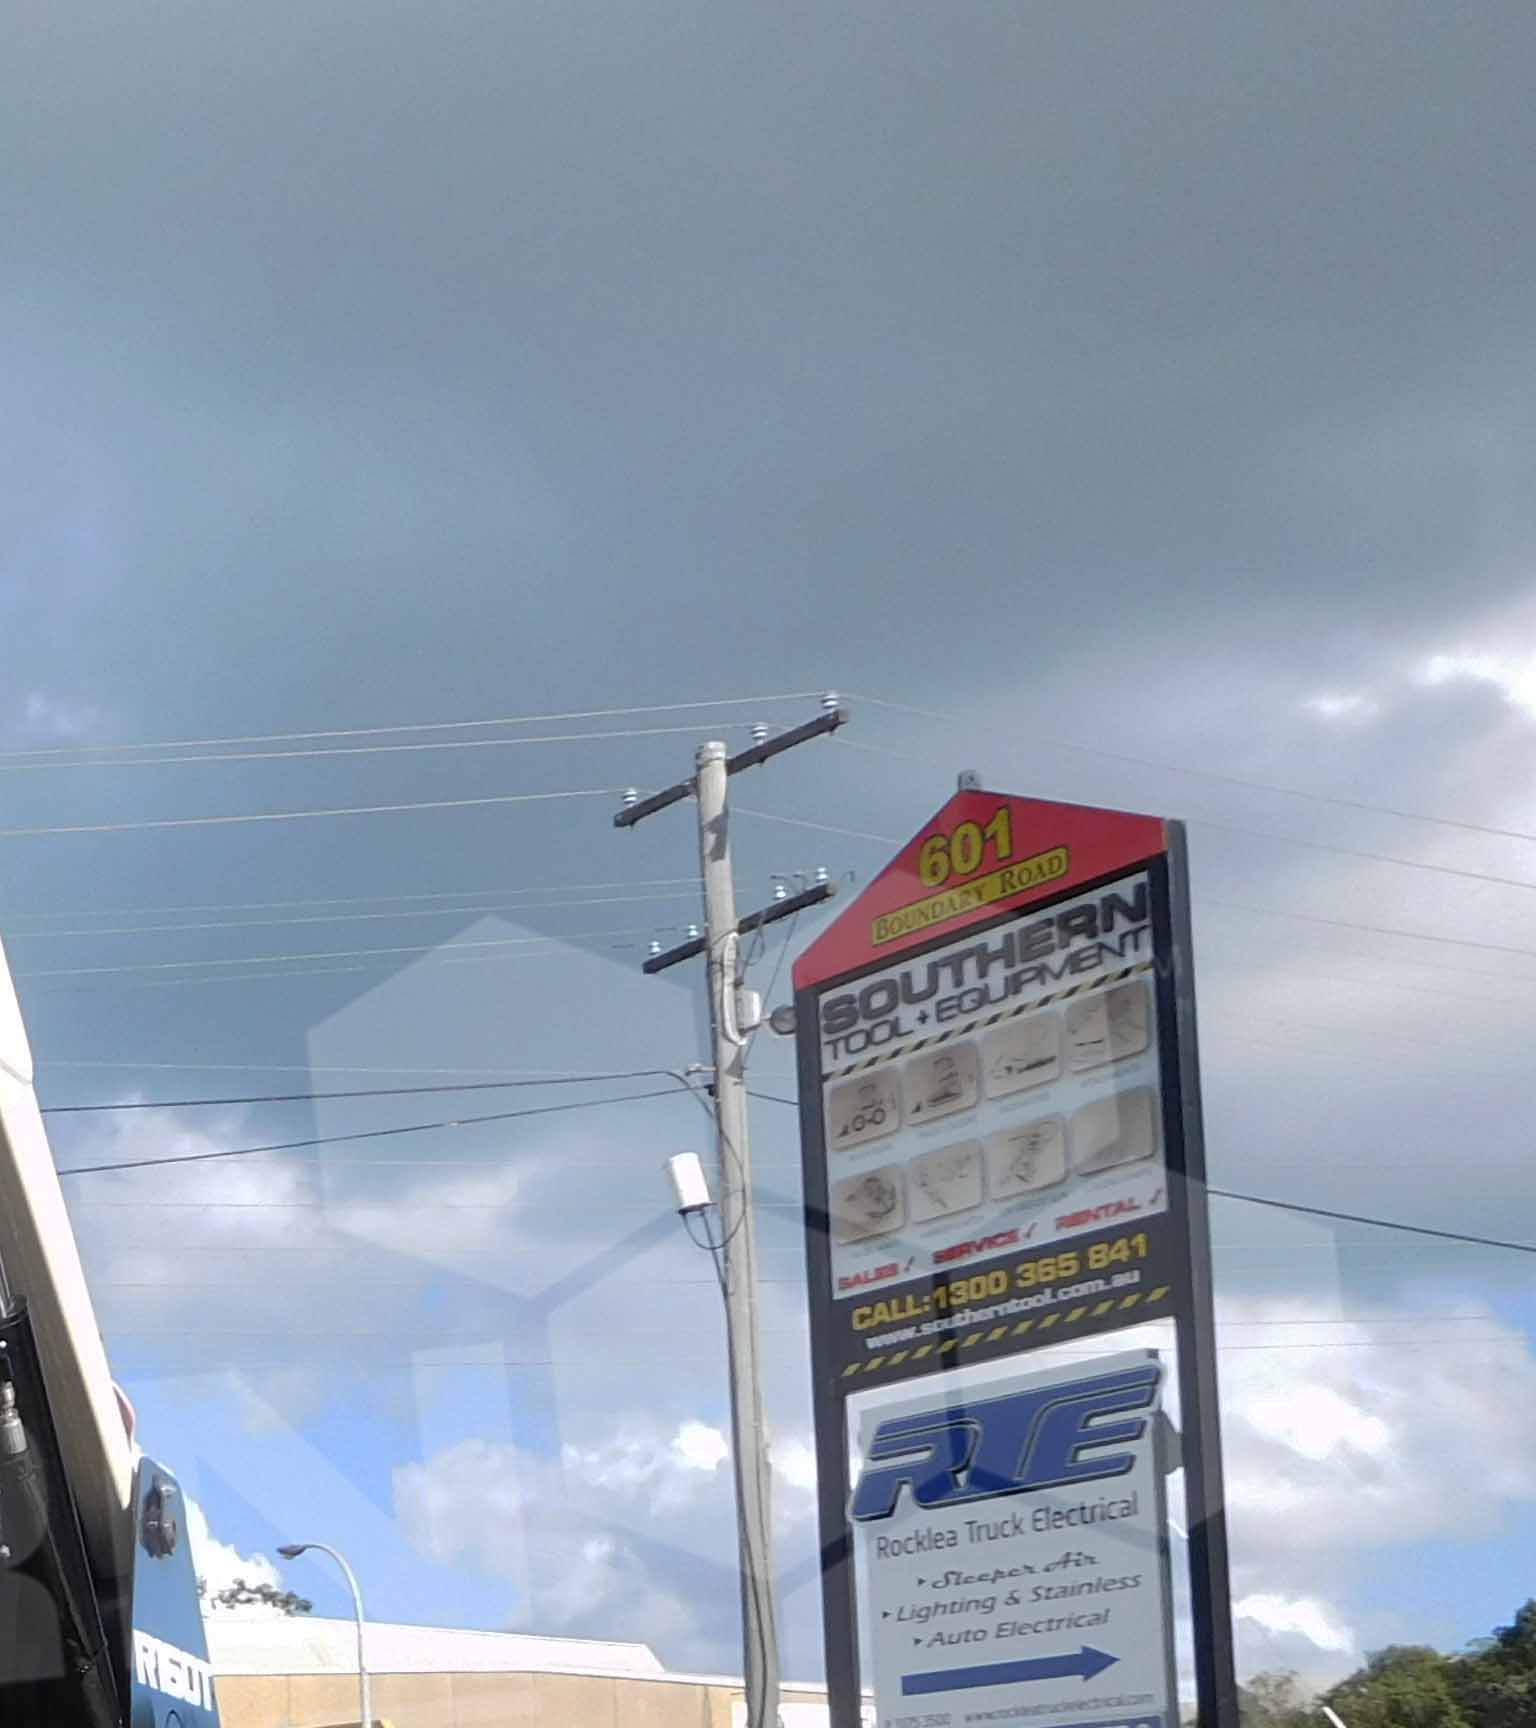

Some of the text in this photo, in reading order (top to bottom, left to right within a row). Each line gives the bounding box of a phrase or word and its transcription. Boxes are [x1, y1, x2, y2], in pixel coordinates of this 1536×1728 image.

[920, 803, 1014, 889] 601
[877, 854, 1064, 941] BOUNDARY ROAD
[822, 884, 1149, 1035] SOUTHERN
[823, 1014, 913, 1061] TOOL
[936, 923, 1153, 1024] EQUIPMENT
[838, 1263, 899, 1291] SALES
[933, 1228, 1018, 1264] SERVICE
[1055, 1197, 1142, 1231] RENTAL
[1017, 1252, 1079, 1288] 365
[1088, 1232, 1149, 1271] 841
[864, 1269, 1141, 1350] www.southerntool.com.au
[847, 1361, 1164, 1523] RTE
[878, 1491, 1139, 1560] Rocklea Truck Electrical
[1043, 1551, 1100, 1573] Air
[896, 1573, 1144, 1624] Lighting & Stainless
[926, 1608, 1111, 1649] Auto Electrical
